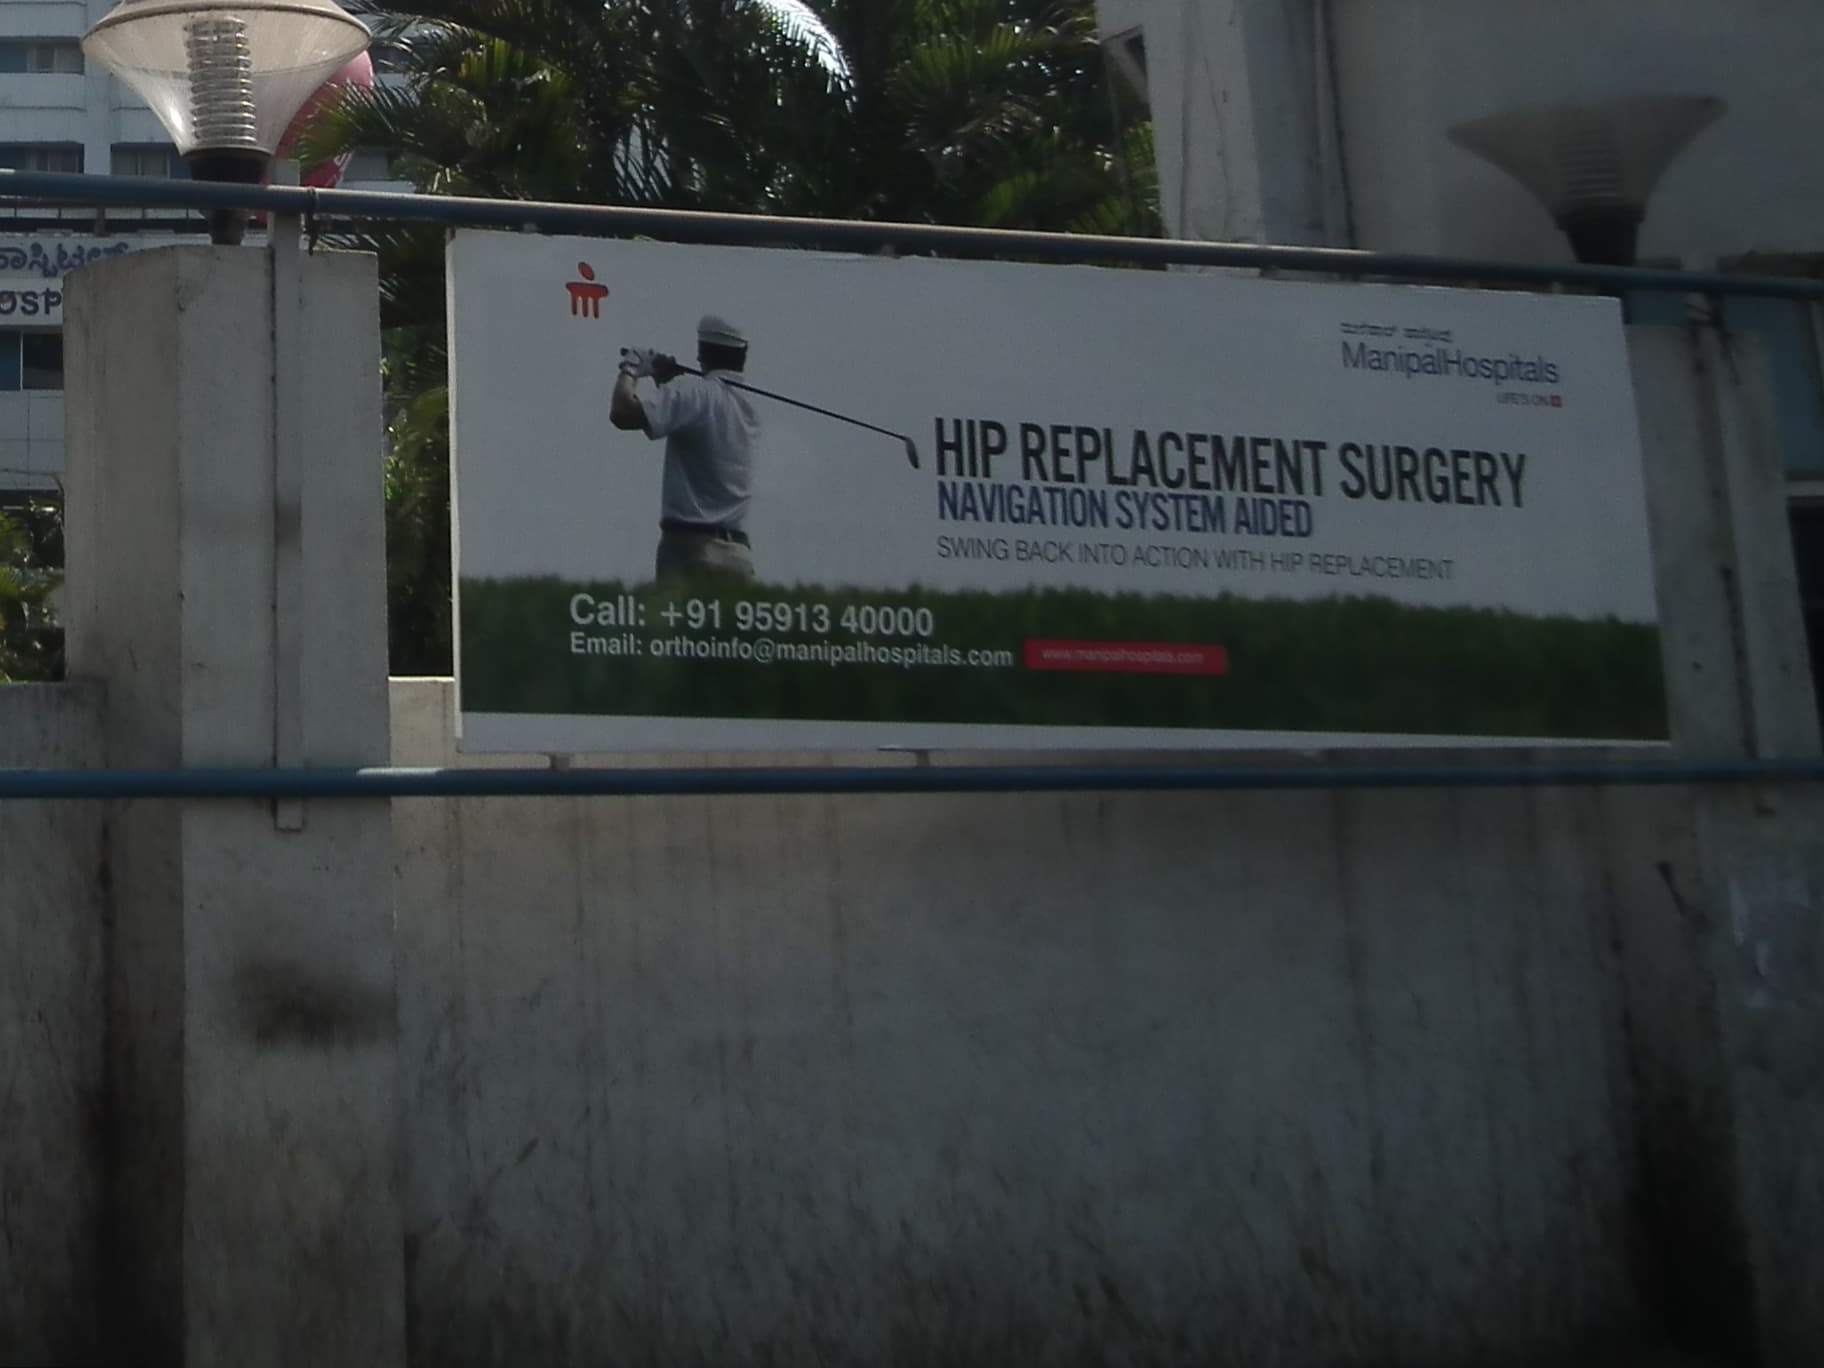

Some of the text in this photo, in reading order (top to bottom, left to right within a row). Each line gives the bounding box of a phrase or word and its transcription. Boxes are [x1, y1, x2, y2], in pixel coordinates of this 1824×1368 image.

[1340, 340, 1561, 386] ManipalHospitals
[935, 417, 1526, 508] HIP REPLACEMENT SURGERY
[937, 480, 1313, 538] NAVIGATION SYSTEM AIDED
[937, 535, 1454, 580] SWING BACK INTO ACTION WITH HIP REPLACEMENT
[570, 593, 934, 636] Call: +91 95913 40000
[570, 631, 1014, 668] Email: orthoinfo@manipalhospitals.com
